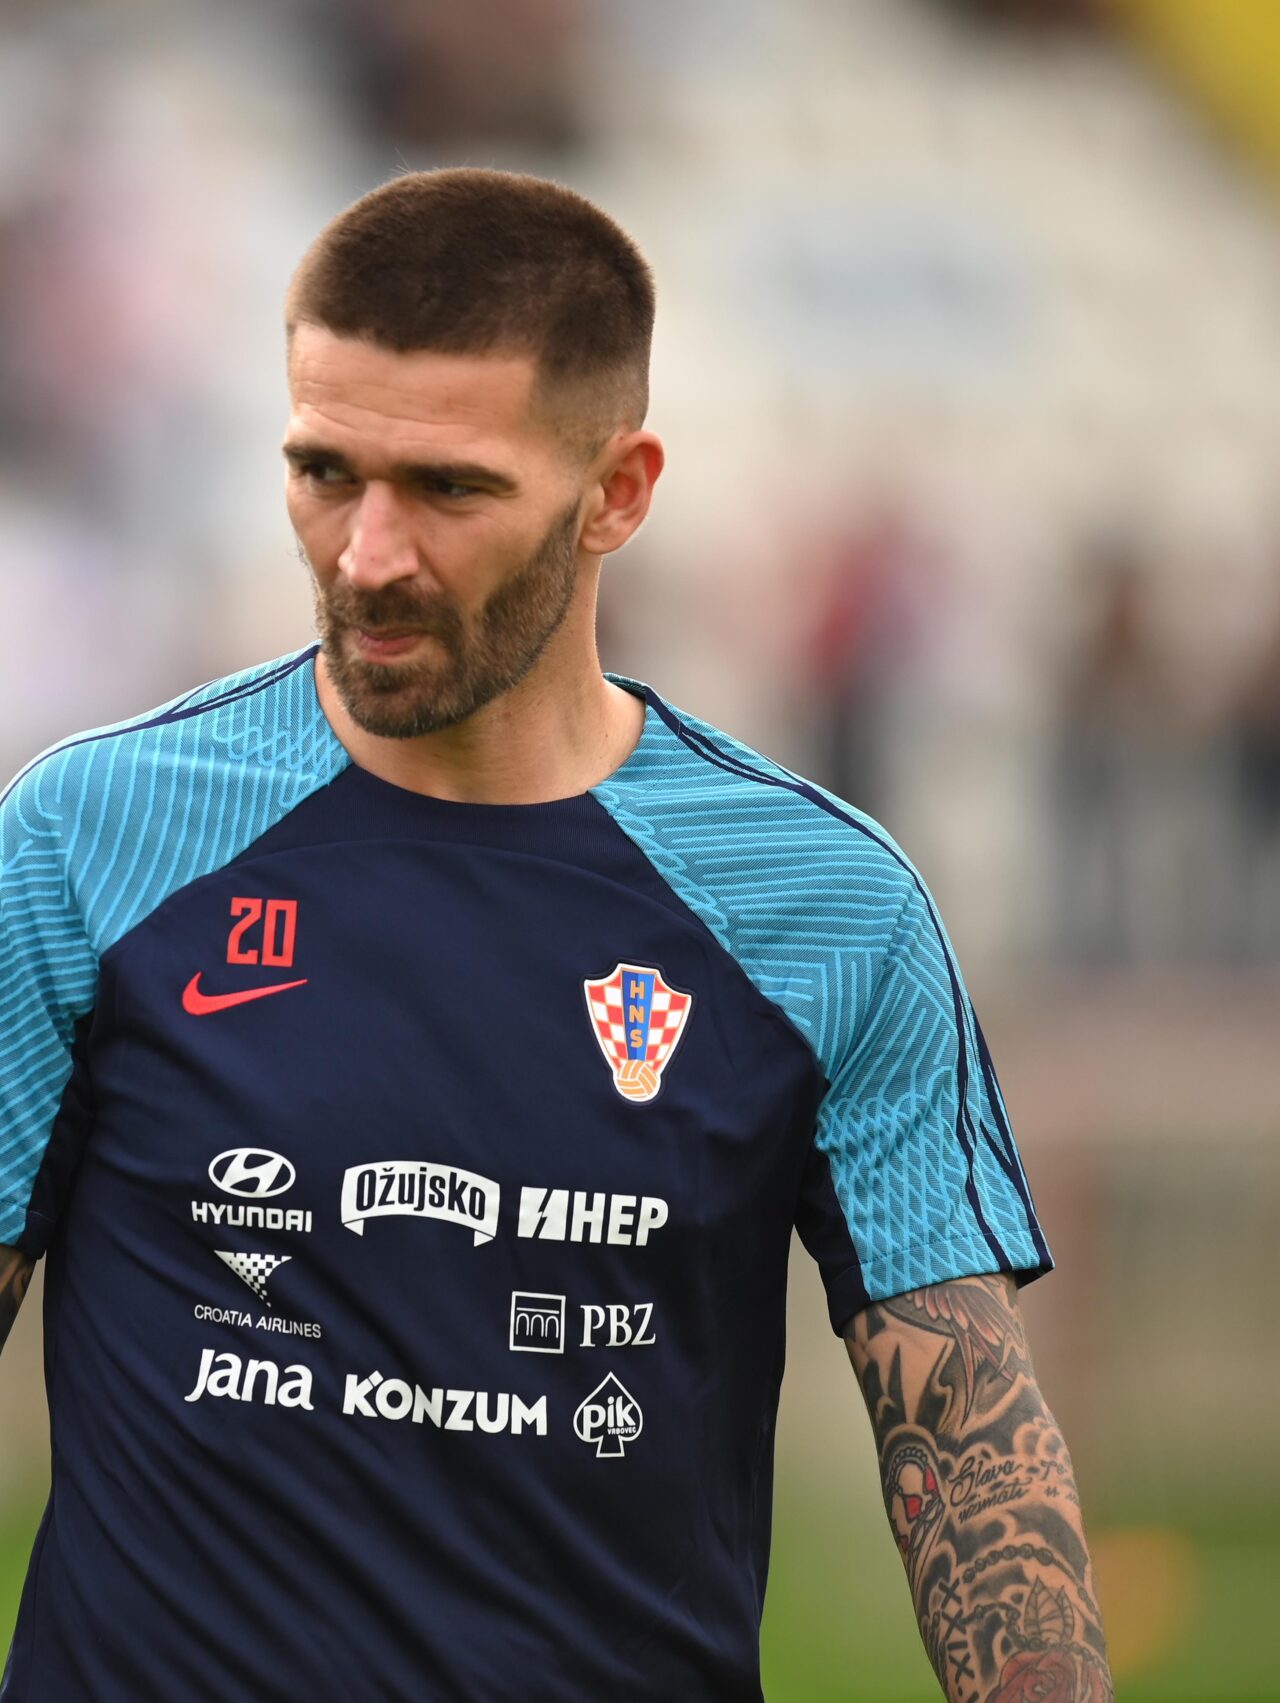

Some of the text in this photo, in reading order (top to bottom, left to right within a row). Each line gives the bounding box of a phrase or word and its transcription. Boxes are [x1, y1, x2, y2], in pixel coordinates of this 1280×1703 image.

[226, 897, 298, 967] 20
[629, 980, 645, 1047] HNS
[192, 1201, 312, 1232] HYUNDAI
[355, 1166, 486, 1221] Ožujsko
[570, 1191, 669, 1246] HEP
[194, 1304, 322, 1339] CROATIA AIRLINES
[580, 1303, 656, 1347] PBZ
[342, 1370, 548, 1436] KONZUM
[583, 1396, 636, 1440] pik
